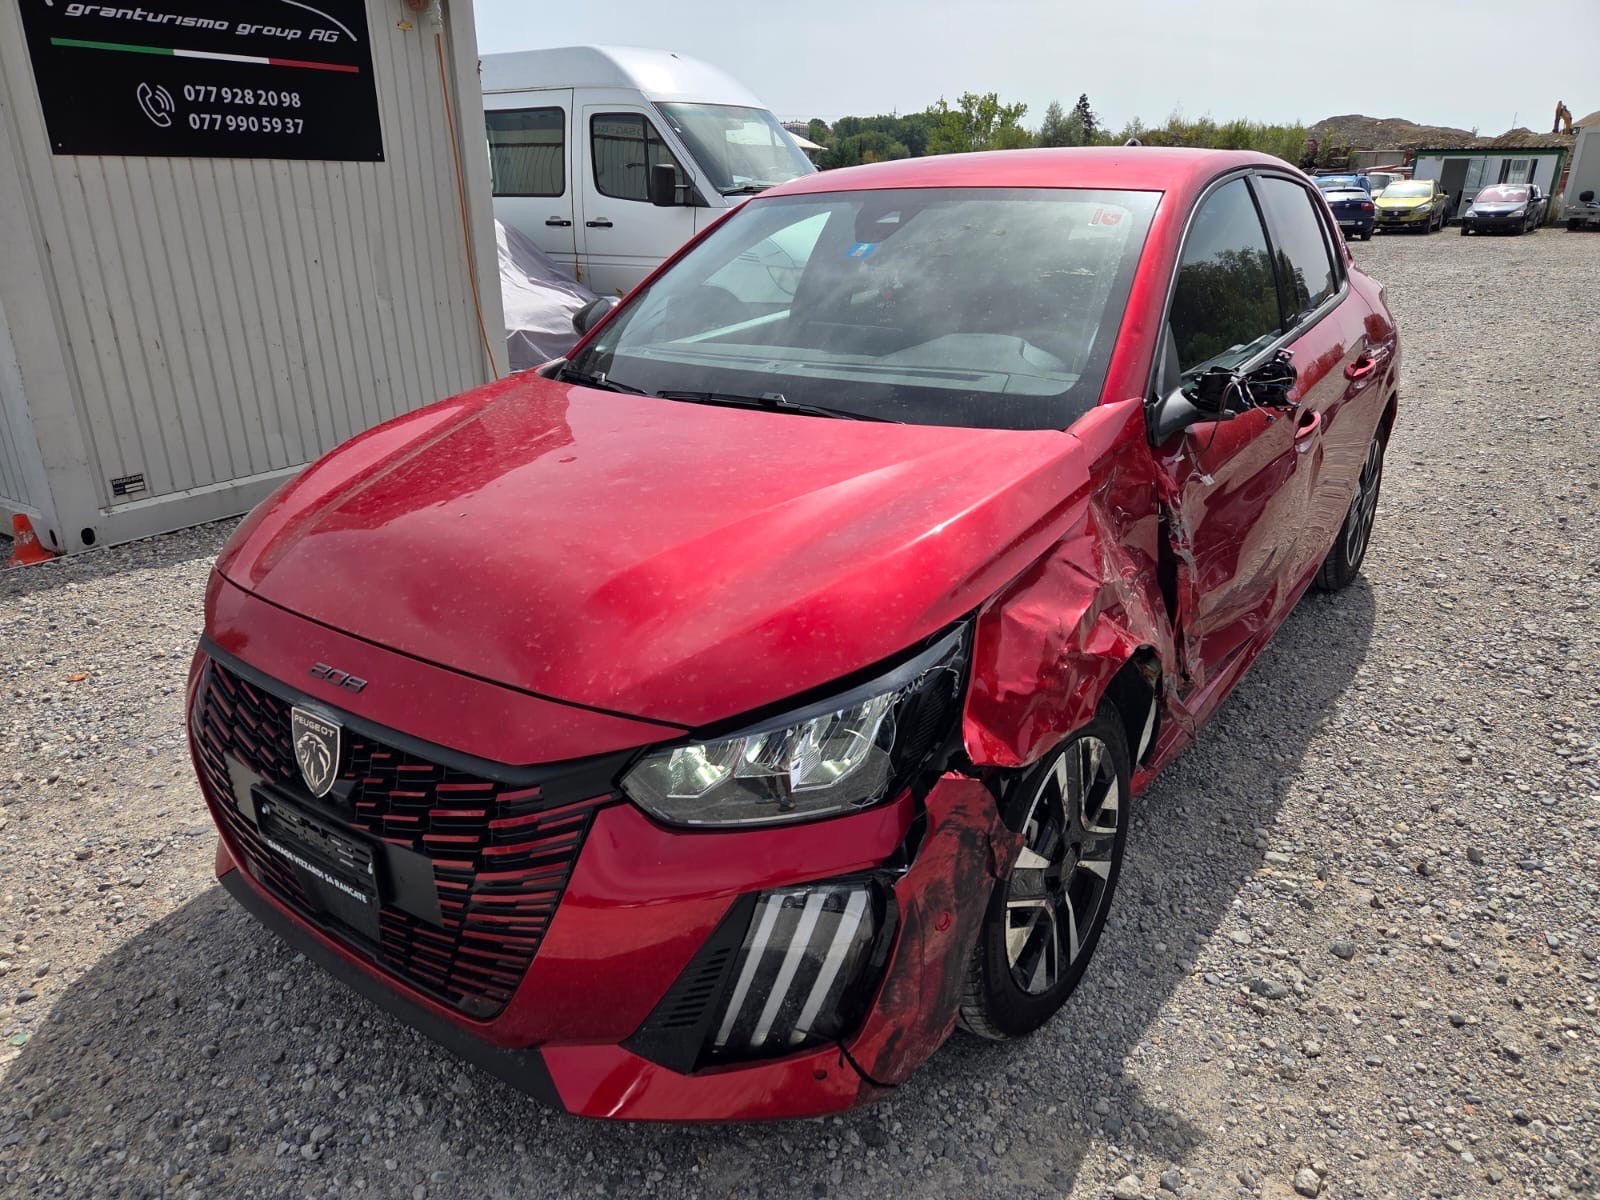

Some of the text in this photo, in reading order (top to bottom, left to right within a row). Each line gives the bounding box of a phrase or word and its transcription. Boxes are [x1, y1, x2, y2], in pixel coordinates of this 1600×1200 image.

[65, 3, 340, 43] granturismo group AG
[184, 85, 301, 108] 077 928 20 98
[188, 113, 304, 134] 077 990 59 37
[310, 662, 368, 692] 208
[294, 714, 335, 737] PEUGEOT
